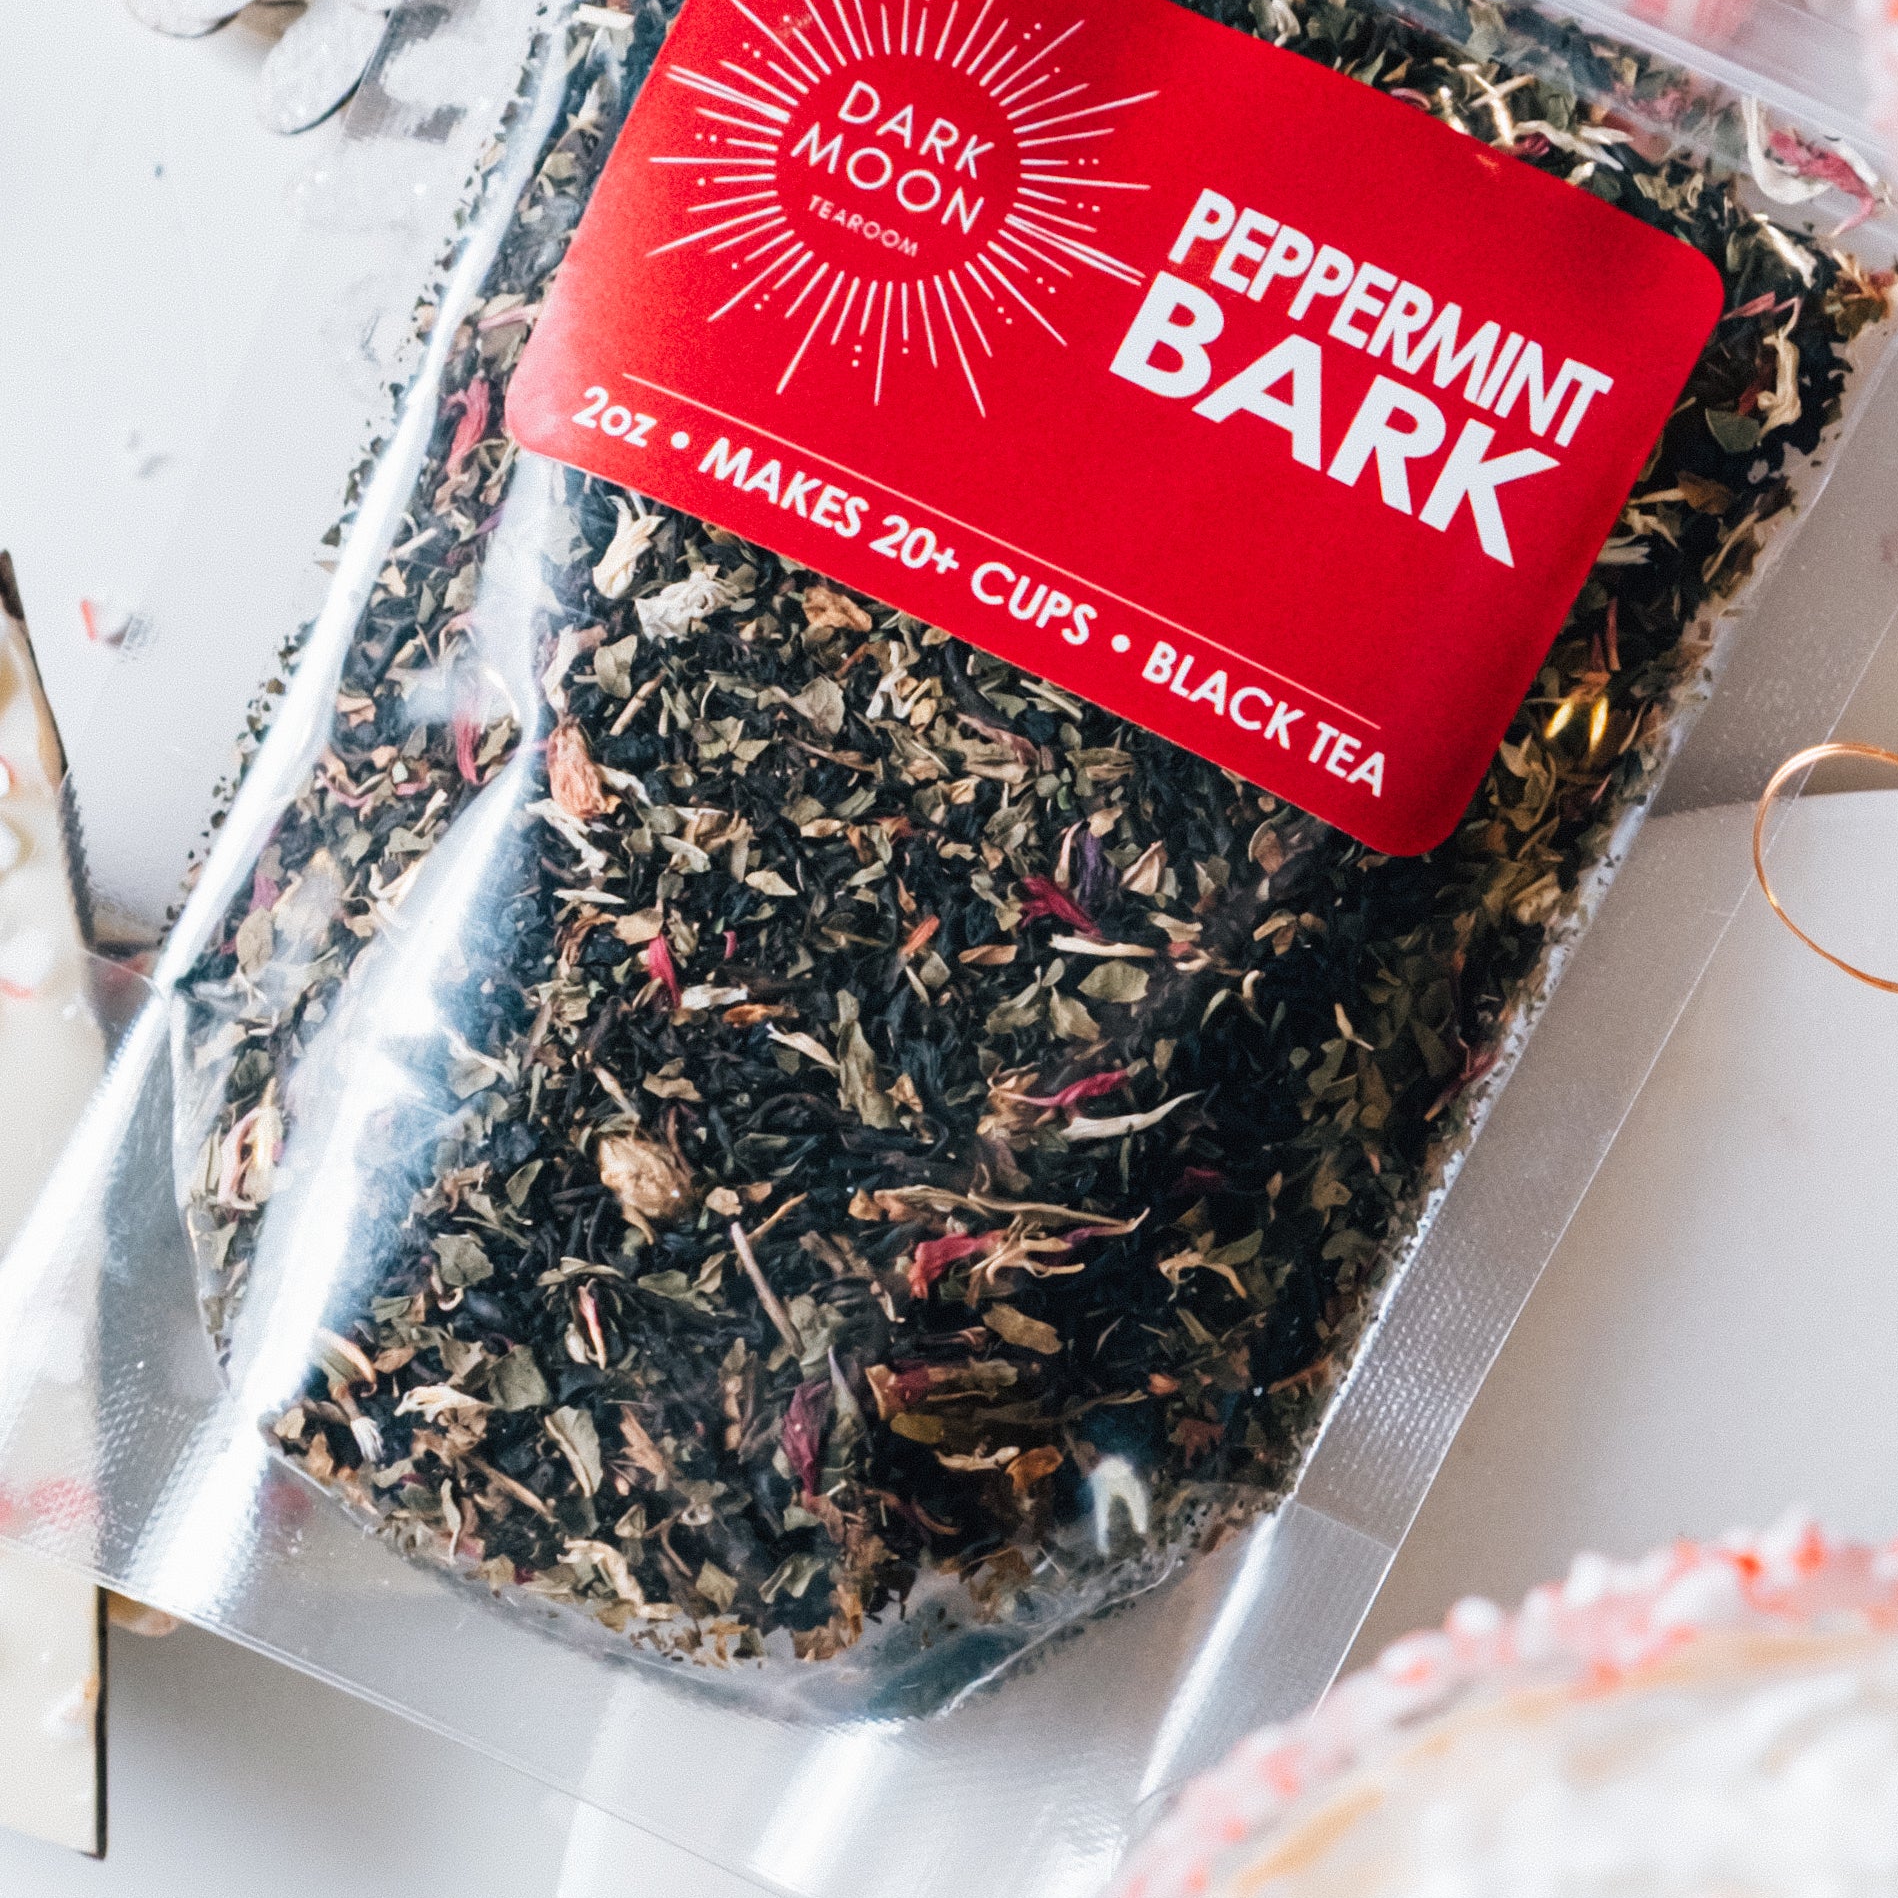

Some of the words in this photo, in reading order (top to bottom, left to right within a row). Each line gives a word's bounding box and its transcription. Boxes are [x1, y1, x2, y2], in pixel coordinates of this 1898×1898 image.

[791, 123, 985, 234] MOON
[838, 81, 995, 179] DARK
[808, 195, 919, 257] TEAROOM
[1168, 189, 1614, 448] PEPPERMINT
[1109, 271, 1561, 568] BARK
[571, 386, 658, 448] 2oz
[698, 438, 870, 539] MAKES
[870, 515, 960, 575] 20+
[971, 562, 1099, 646] CUPS
[1142, 642, 1306, 750] BLACK
[1310, 723, 1387, 798] TEA
